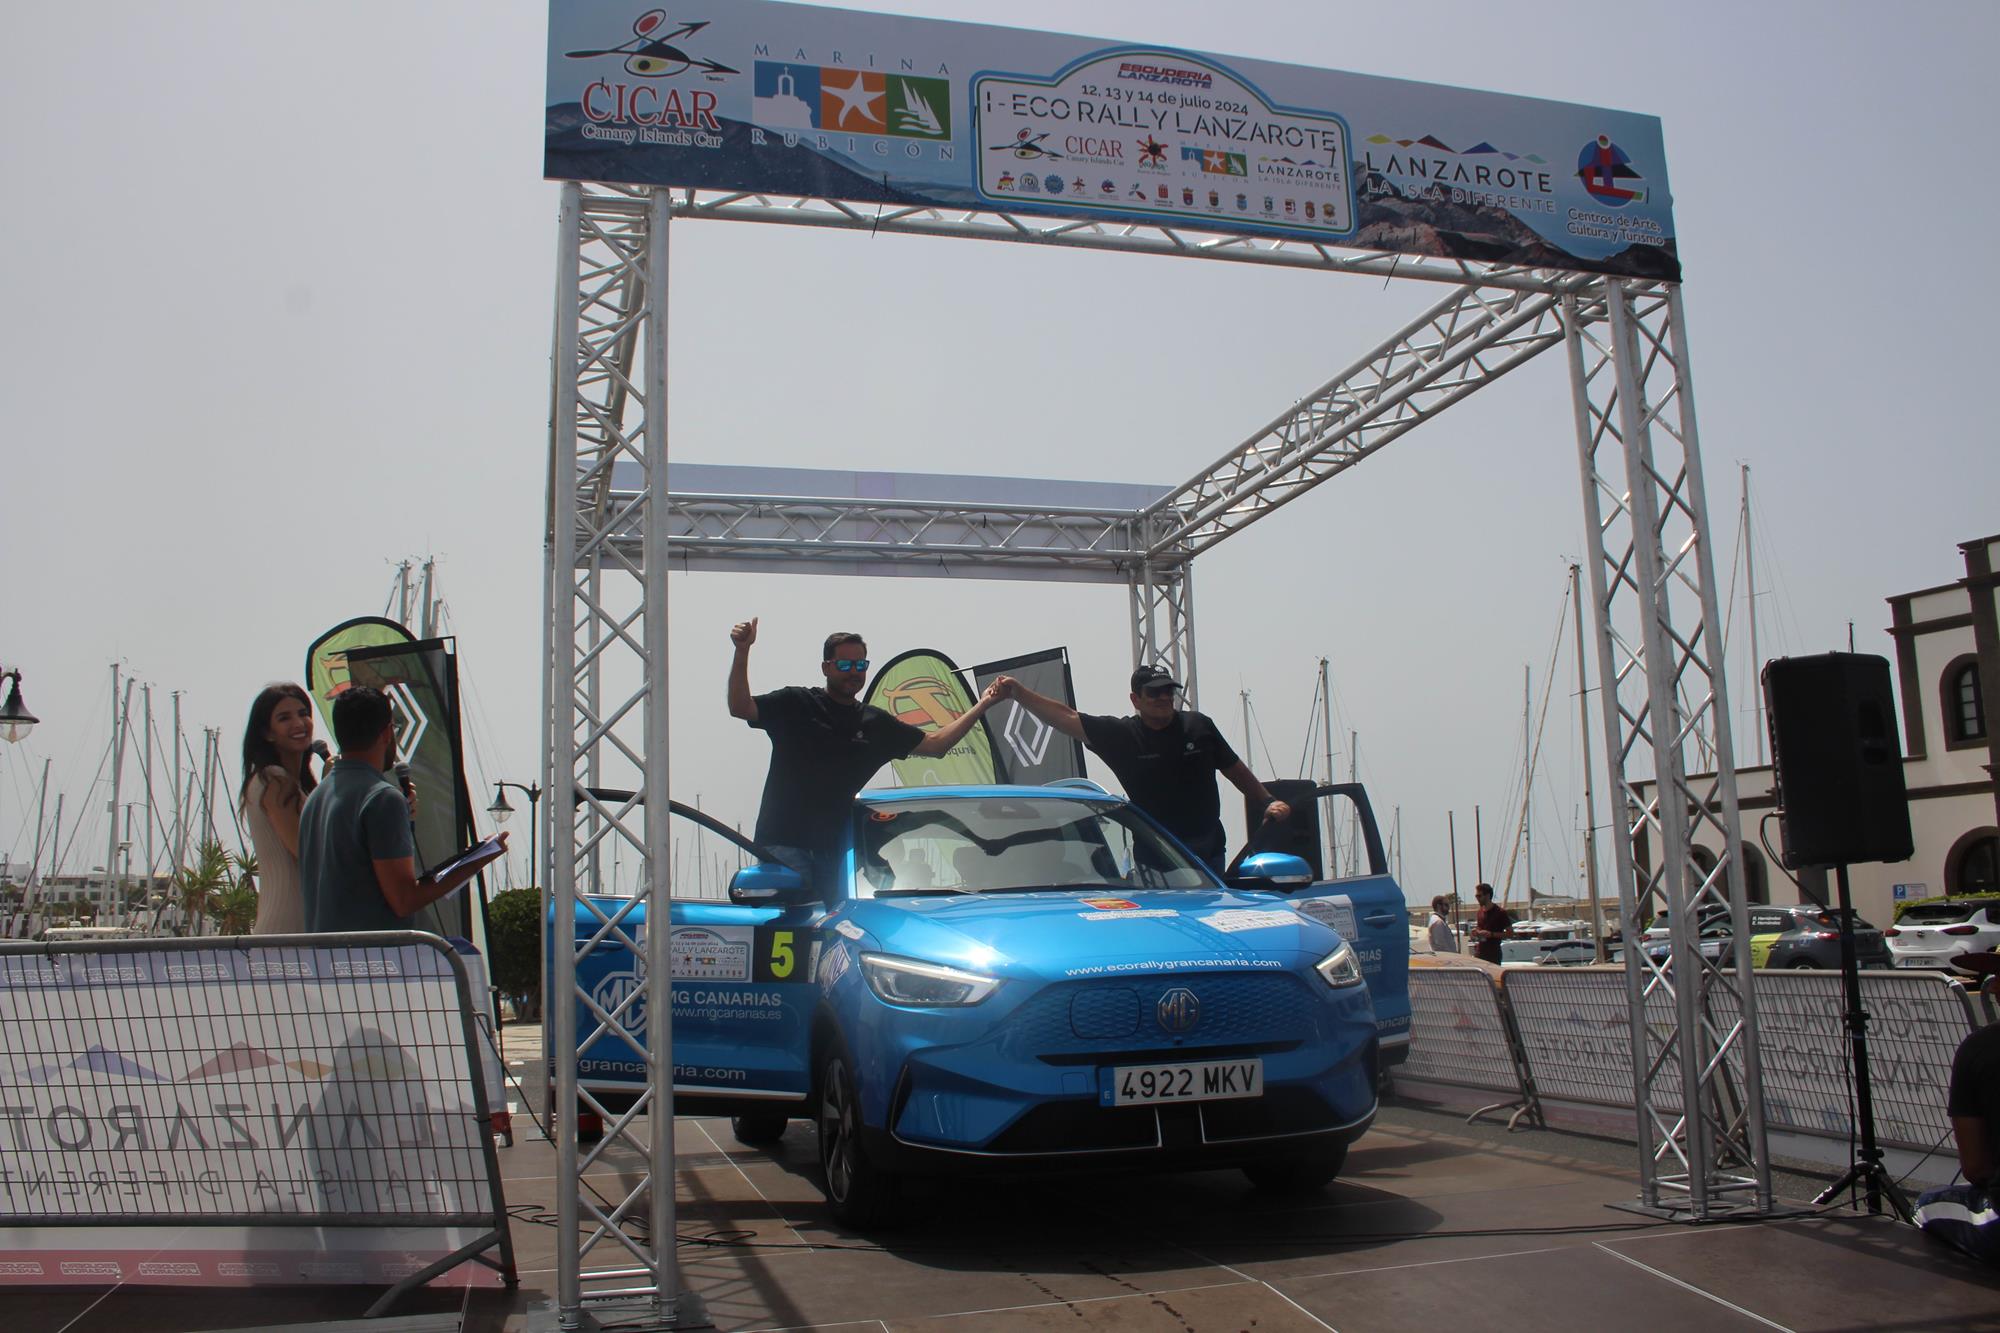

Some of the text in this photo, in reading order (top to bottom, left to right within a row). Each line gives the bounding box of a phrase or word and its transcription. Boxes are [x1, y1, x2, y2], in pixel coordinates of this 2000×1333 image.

[755, 43, 949, 75] MARINA
[1117, 71, 1212, 89] LANZAROTE
[1120, 63, 1212, 81] ESCUDERIA
[583, 82, 720, 129] CICAR
[1106, 87, 1121, 100] 13
[1125, 90, 1134, 103] y
[1138, 91, 1154, 104] 14
[1158, 92, 1177, 105] de
[1180, 93, 1211, 110] julio
[1215, 100, 1248, 116] 2024
[583, 124, 722, 147] Canary Islands Car
[1078, 100, 1168, 130] RALLY
[1176, 112, 1335, 151] LANZAROTE
[751, 129, 955, 161] RUBICÓN
[1065, 135, 1123, 158] CICAR
[1258, 163, 1341, 182] LANZAROTE
[1366, 151, 1552, 192] LANZAROTE
[1295, 180, 1341, 191] DIFERENTE
[1367, 178, 1556, 214] LA ISLA DIFERENTE
[1568, 208, 1662, 233] Centros de Arte,
[1567, 222, 1664, 246] Cultura y Turismo
[672, 946, 745, 955] ALLY LANZAROTE
[770, 931, 794, 978] 5
[1065, 958, 1281, 977] www.ecorallygrancanaria.com
[694, 991, 782, 1007] CANARIAS
[1122, 1065, 1254, 1099] 4922 MKV
